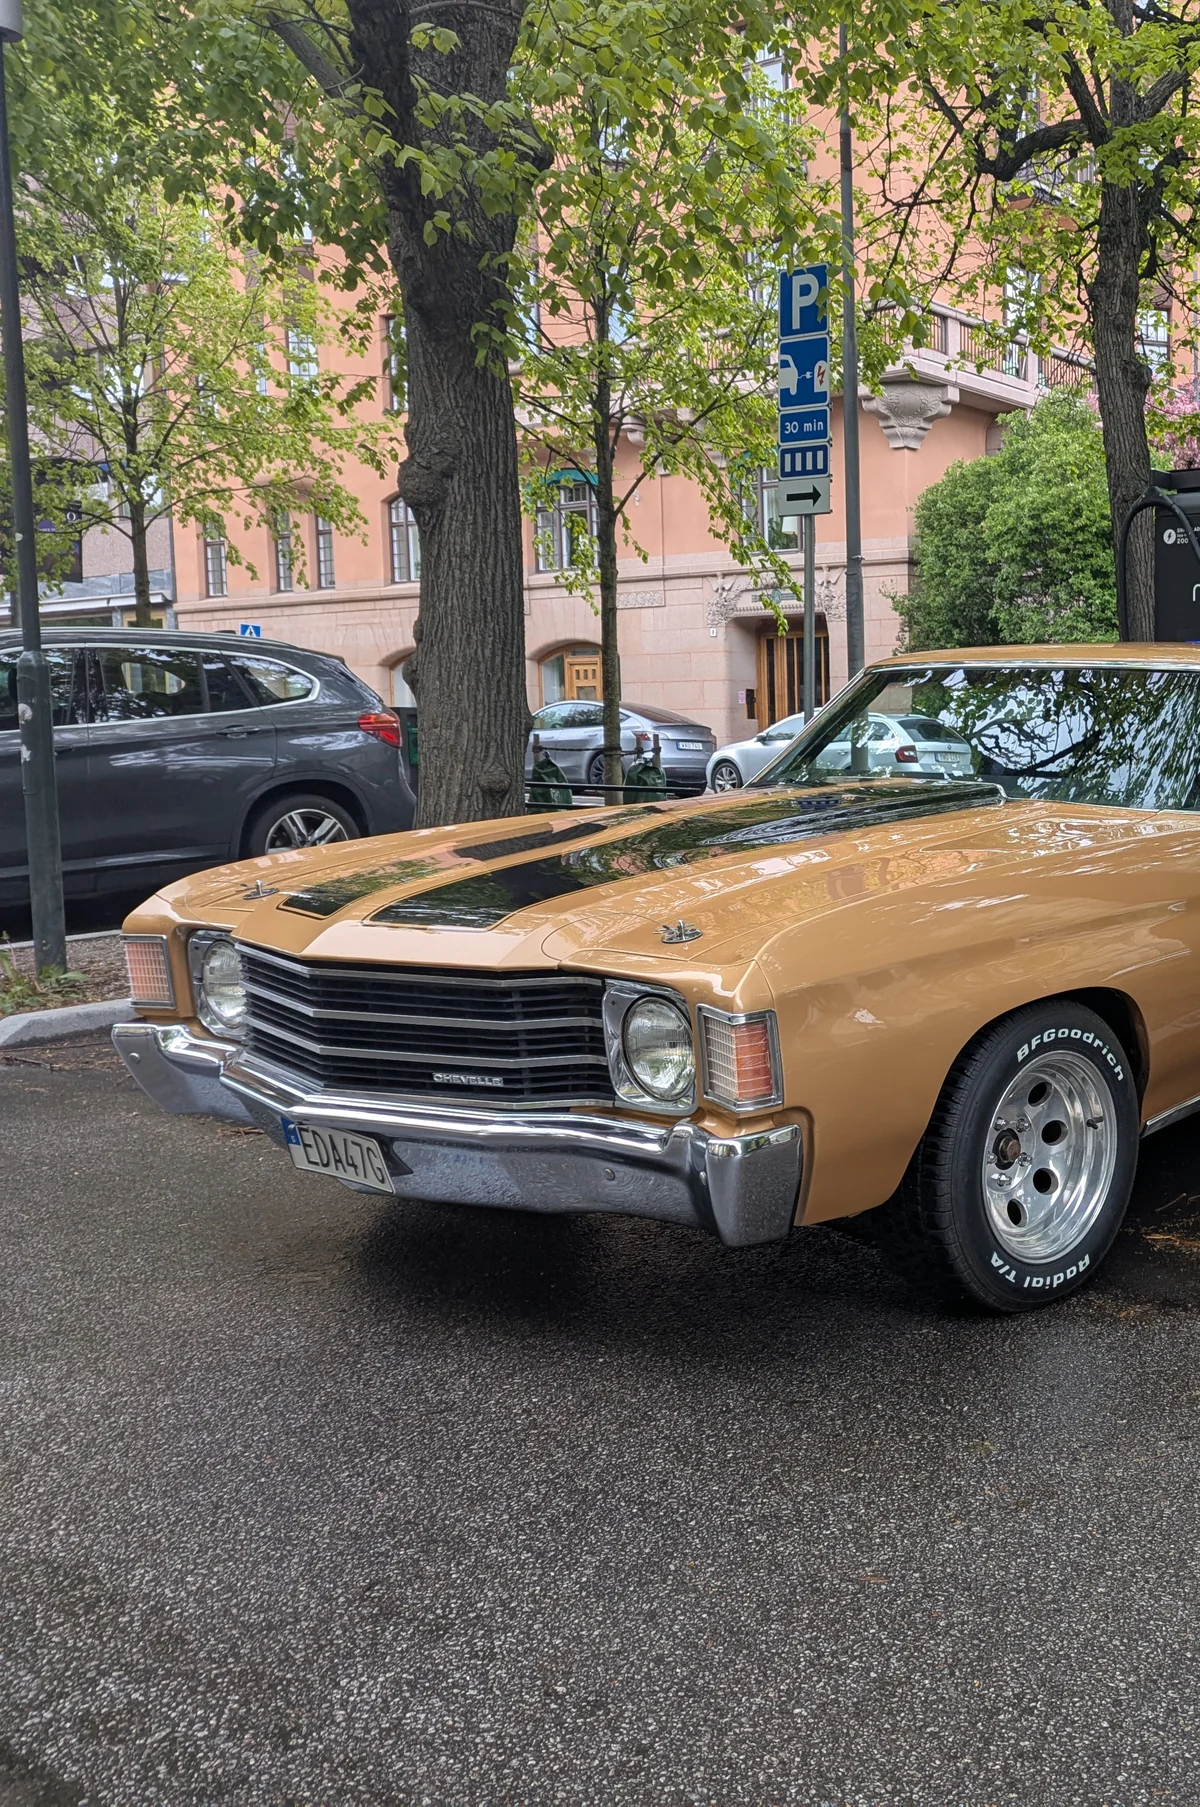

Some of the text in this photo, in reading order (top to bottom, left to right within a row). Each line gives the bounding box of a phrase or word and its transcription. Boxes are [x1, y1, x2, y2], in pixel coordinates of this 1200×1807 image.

[792, 273, 820, 330] P
[784, 419, 824, 434] 30 min
[1016, 1028, 1125, 1081] BFGoodrich
[432, 1073, 504, 1087] CHEVELLE
[990, 1251, 1091, 1289] Radial T/A
